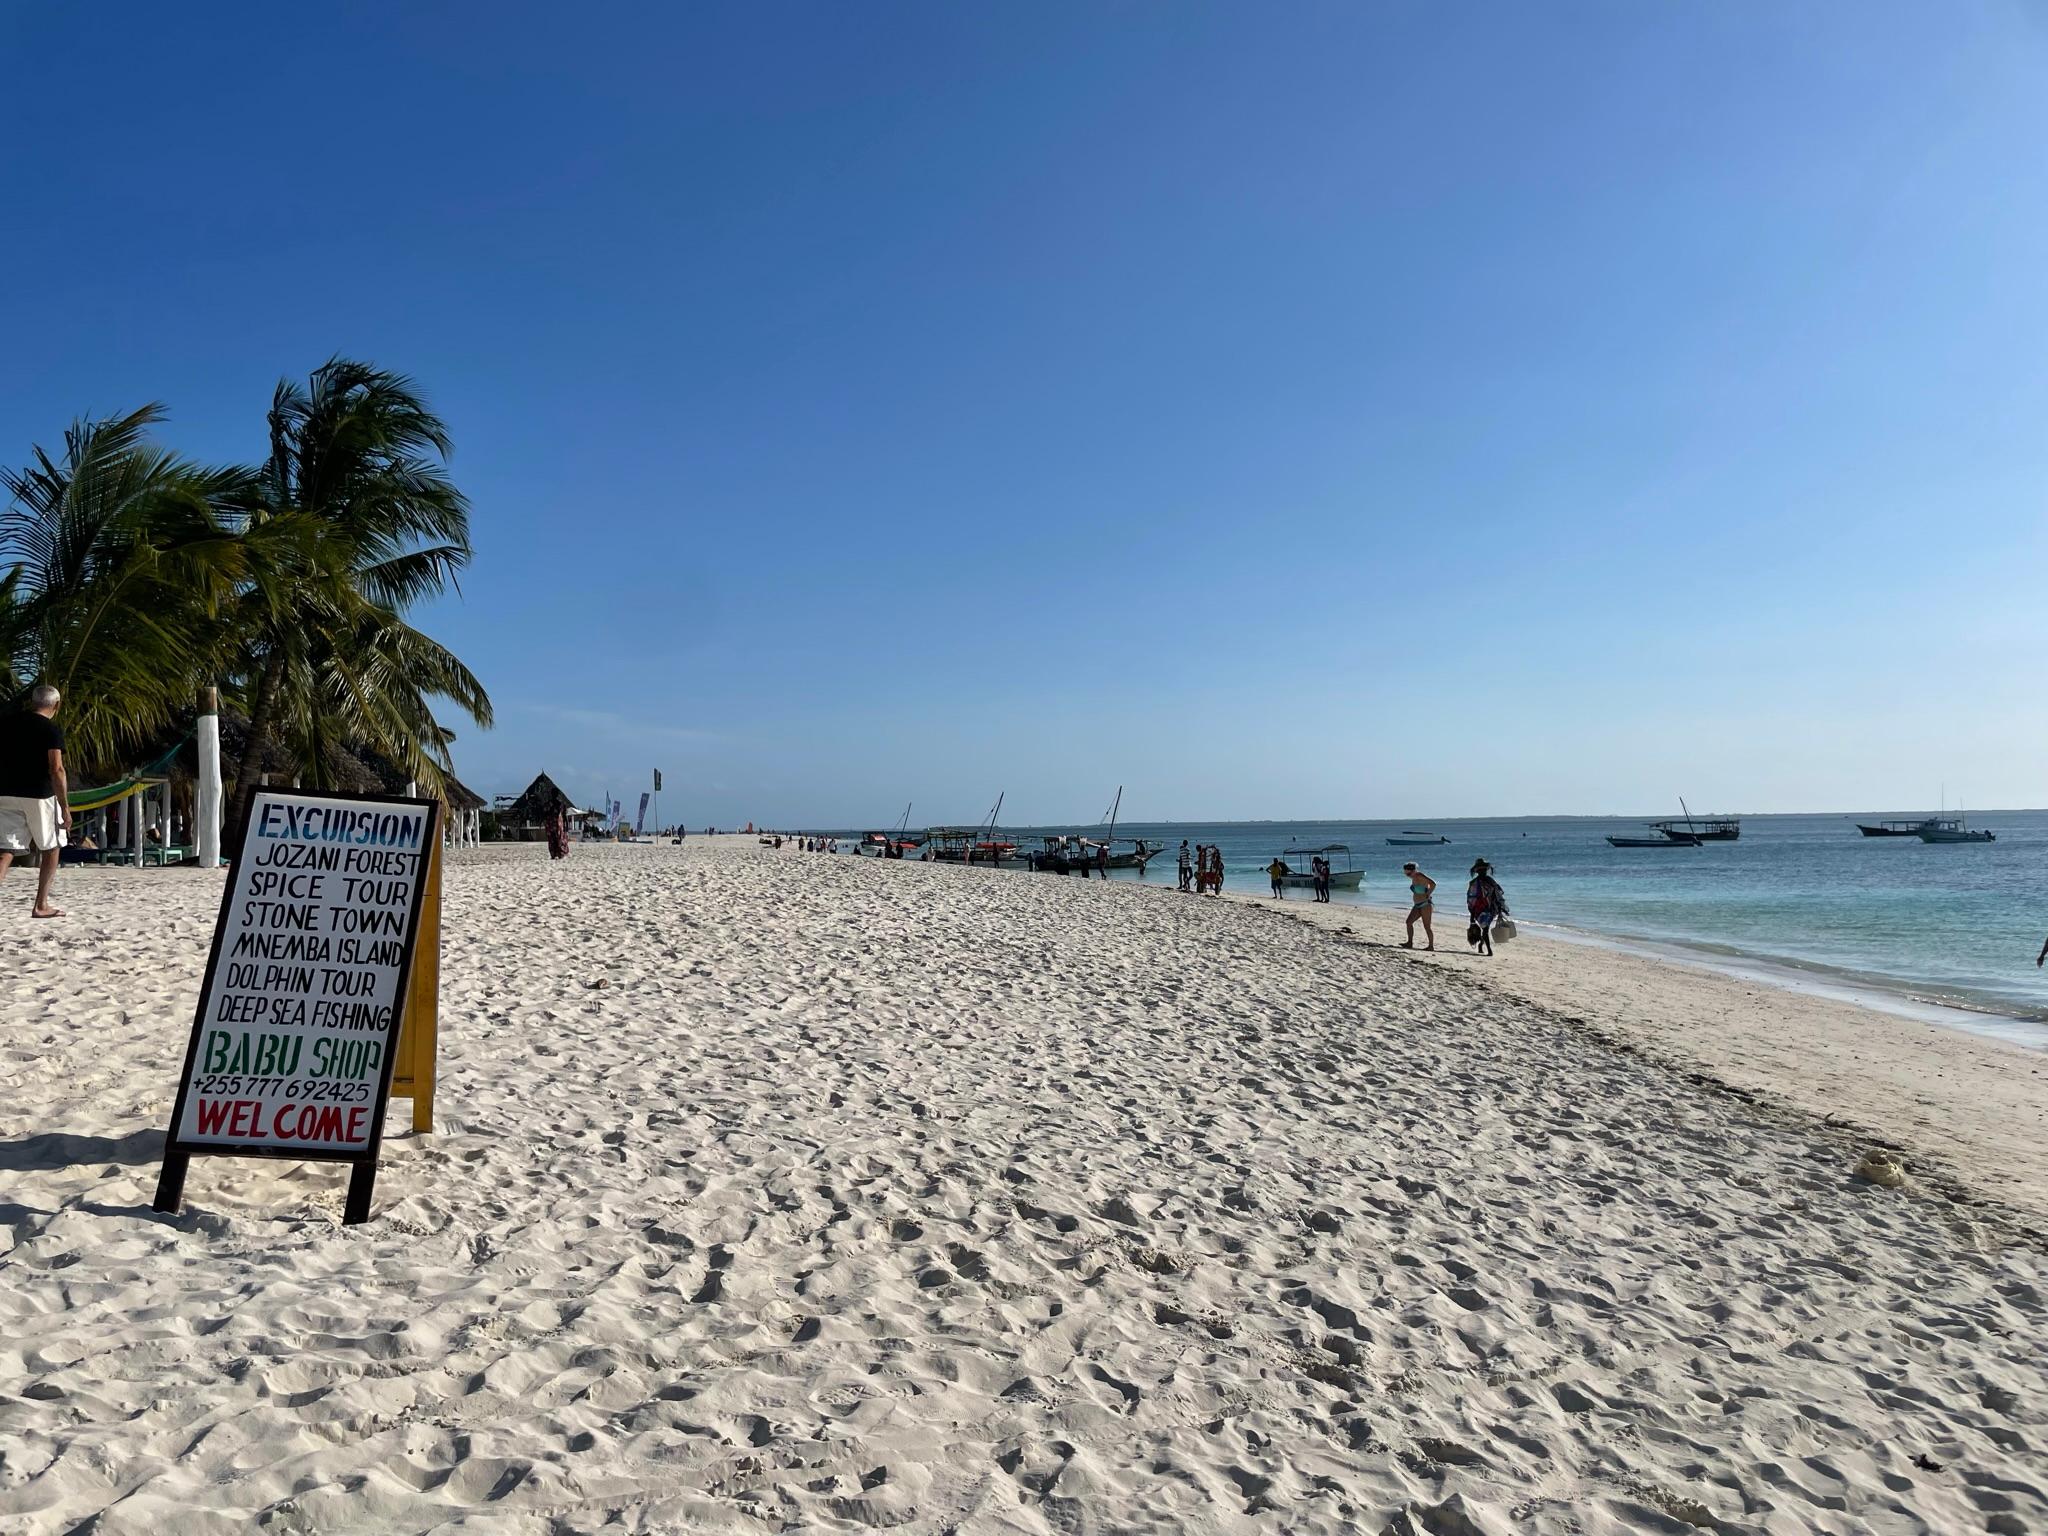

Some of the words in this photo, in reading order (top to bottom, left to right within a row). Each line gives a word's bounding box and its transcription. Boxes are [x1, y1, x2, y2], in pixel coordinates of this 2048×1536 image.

[258, 803, 422, 848] EXCURSION
[256, 843, 341, 871] JOZANI
[344, 848, 422, 877] FOREST
[248, 871, 325, 899] SPICE
[343, 878, 409, 906] TOUR
[242, 901, 320, 931] STONE
[329, 906, 405, 936] TOWN
[231, 932, 330, 962] MNEMBA
[337, 938, 405, 967] ISLAND
[226, 962, 315, 994] DOLPHIN
[321, 969, 376, 997] TOUR
[217, 994, 268, 1023] DEEP
[269, 998, 305, 1025] SEA
[311, 1000, 392, 1031] FISHING
[203, 1030, 303, 1076] BABU
[310, 1037, 382, 1080] SHOP
[198, 1099, 369, 1143] WELCOME
